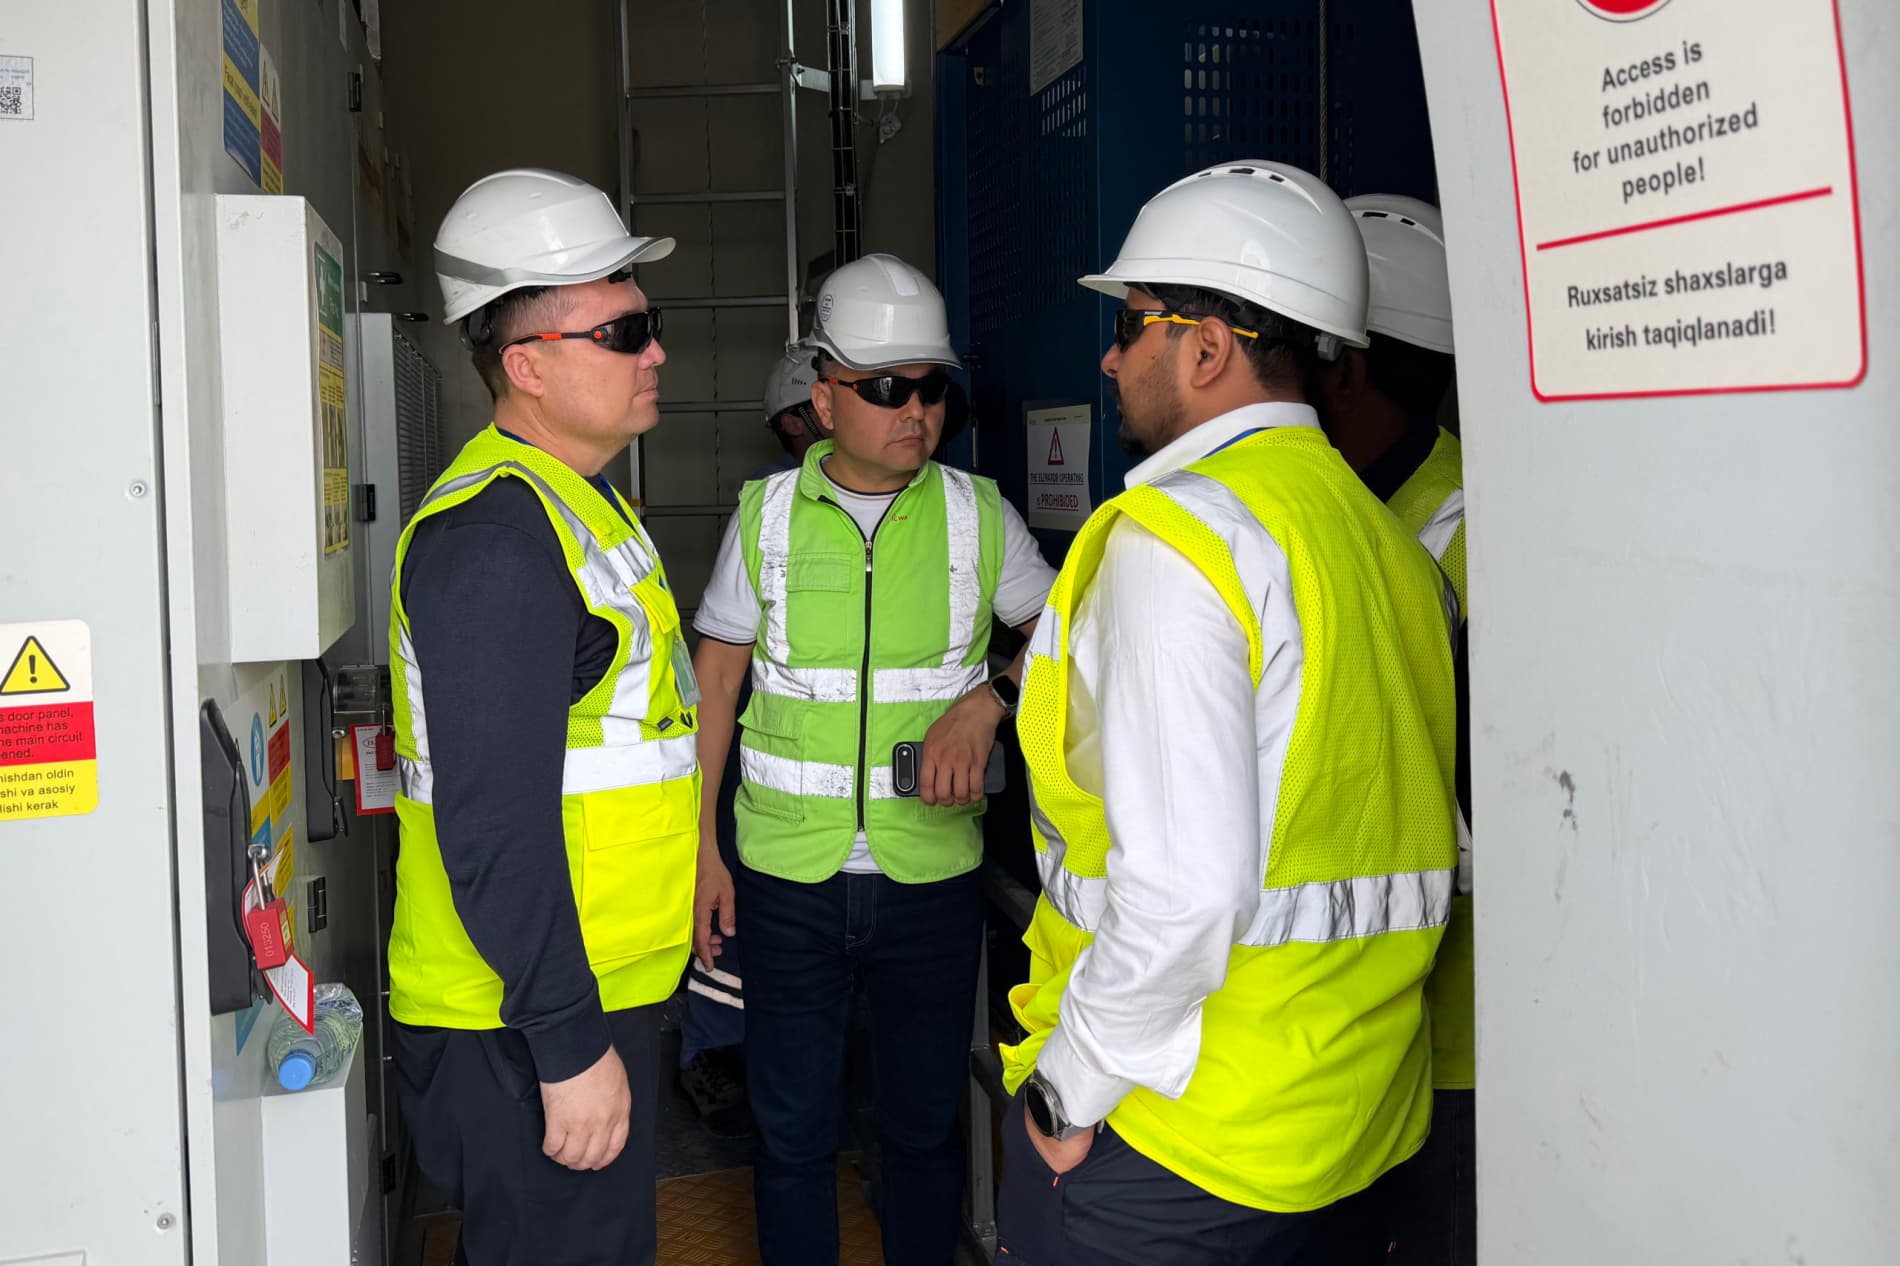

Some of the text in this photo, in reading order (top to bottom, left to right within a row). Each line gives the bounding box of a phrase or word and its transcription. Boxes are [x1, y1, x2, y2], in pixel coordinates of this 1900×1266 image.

[1602, 40, 1702, 92] Access is
[1602, 79, 1710, 129] forbidden
[1573, 101, 1759, 173] for unauthorized
[1622, 156, 1705, 204] people!
[1567, 260, 1788, 308] Ruxsatsiz shaxslarga
[1586, 308, 1776, 351] kirish taqiqlanadi!
[8, 711, 34, 721] door
[47, 721, 68, 731] has
[16, 735, 44, 746] main
[48, 731, 83, 743] circuit
[0, 748, 33, 760] ened.
[46, 769, 74, 780] oldin
[21, 788, 34, 797] va
[39, 783, 76, 795] asosiy
[26, 800, 59, 811] kerak
